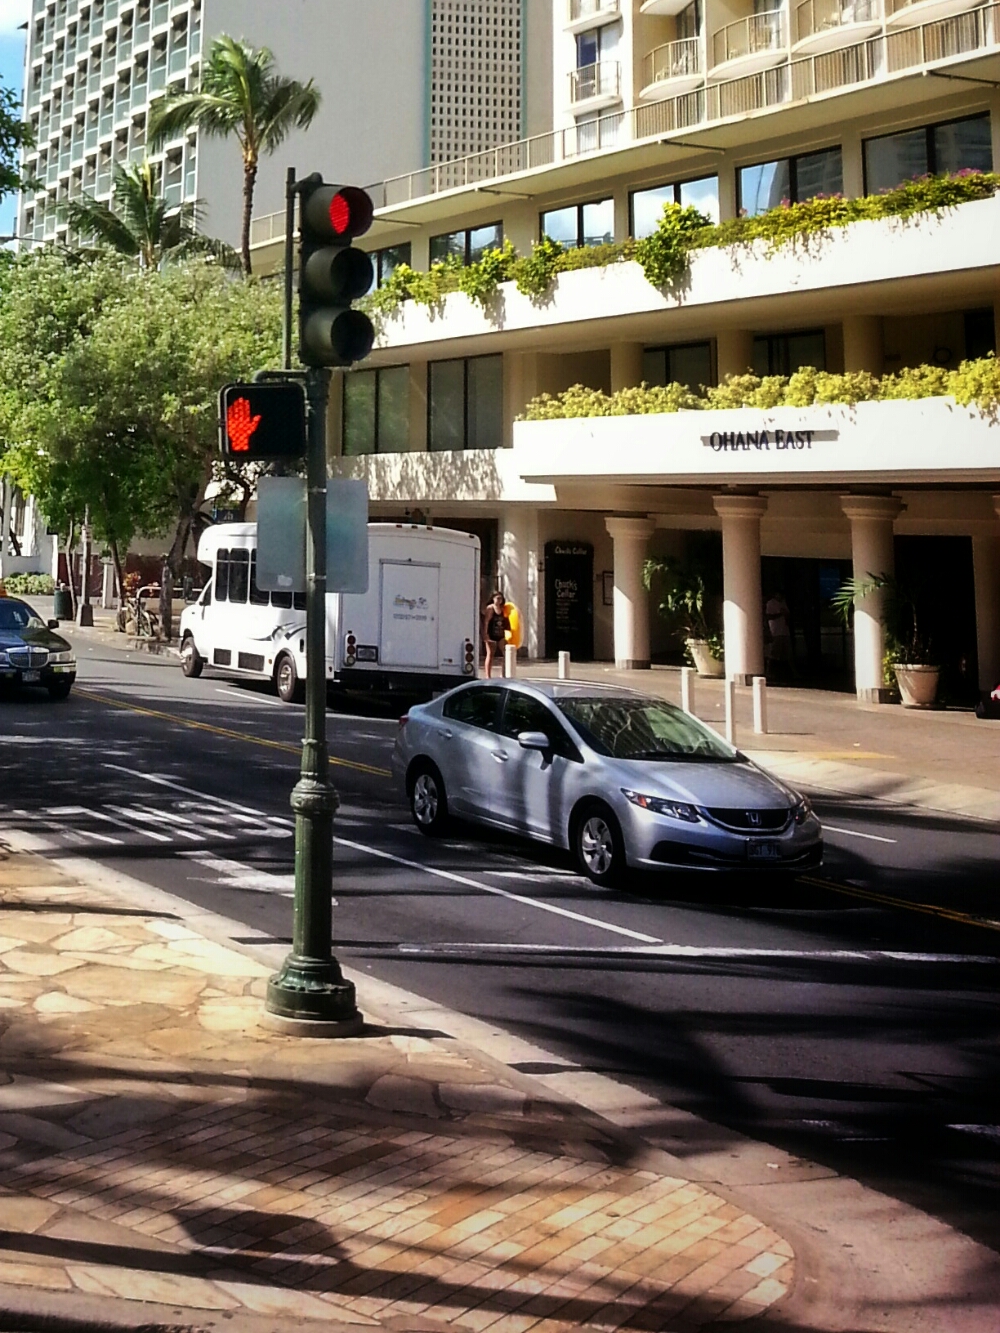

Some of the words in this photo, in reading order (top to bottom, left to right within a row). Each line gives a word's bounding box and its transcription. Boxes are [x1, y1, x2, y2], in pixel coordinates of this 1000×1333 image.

[709, 430, 770, 452] OHANA
[775, 429, 814, 450] EAST
[554, 579, 577, 591] Chuck's
[556, 588, 576, 598] Cellar
